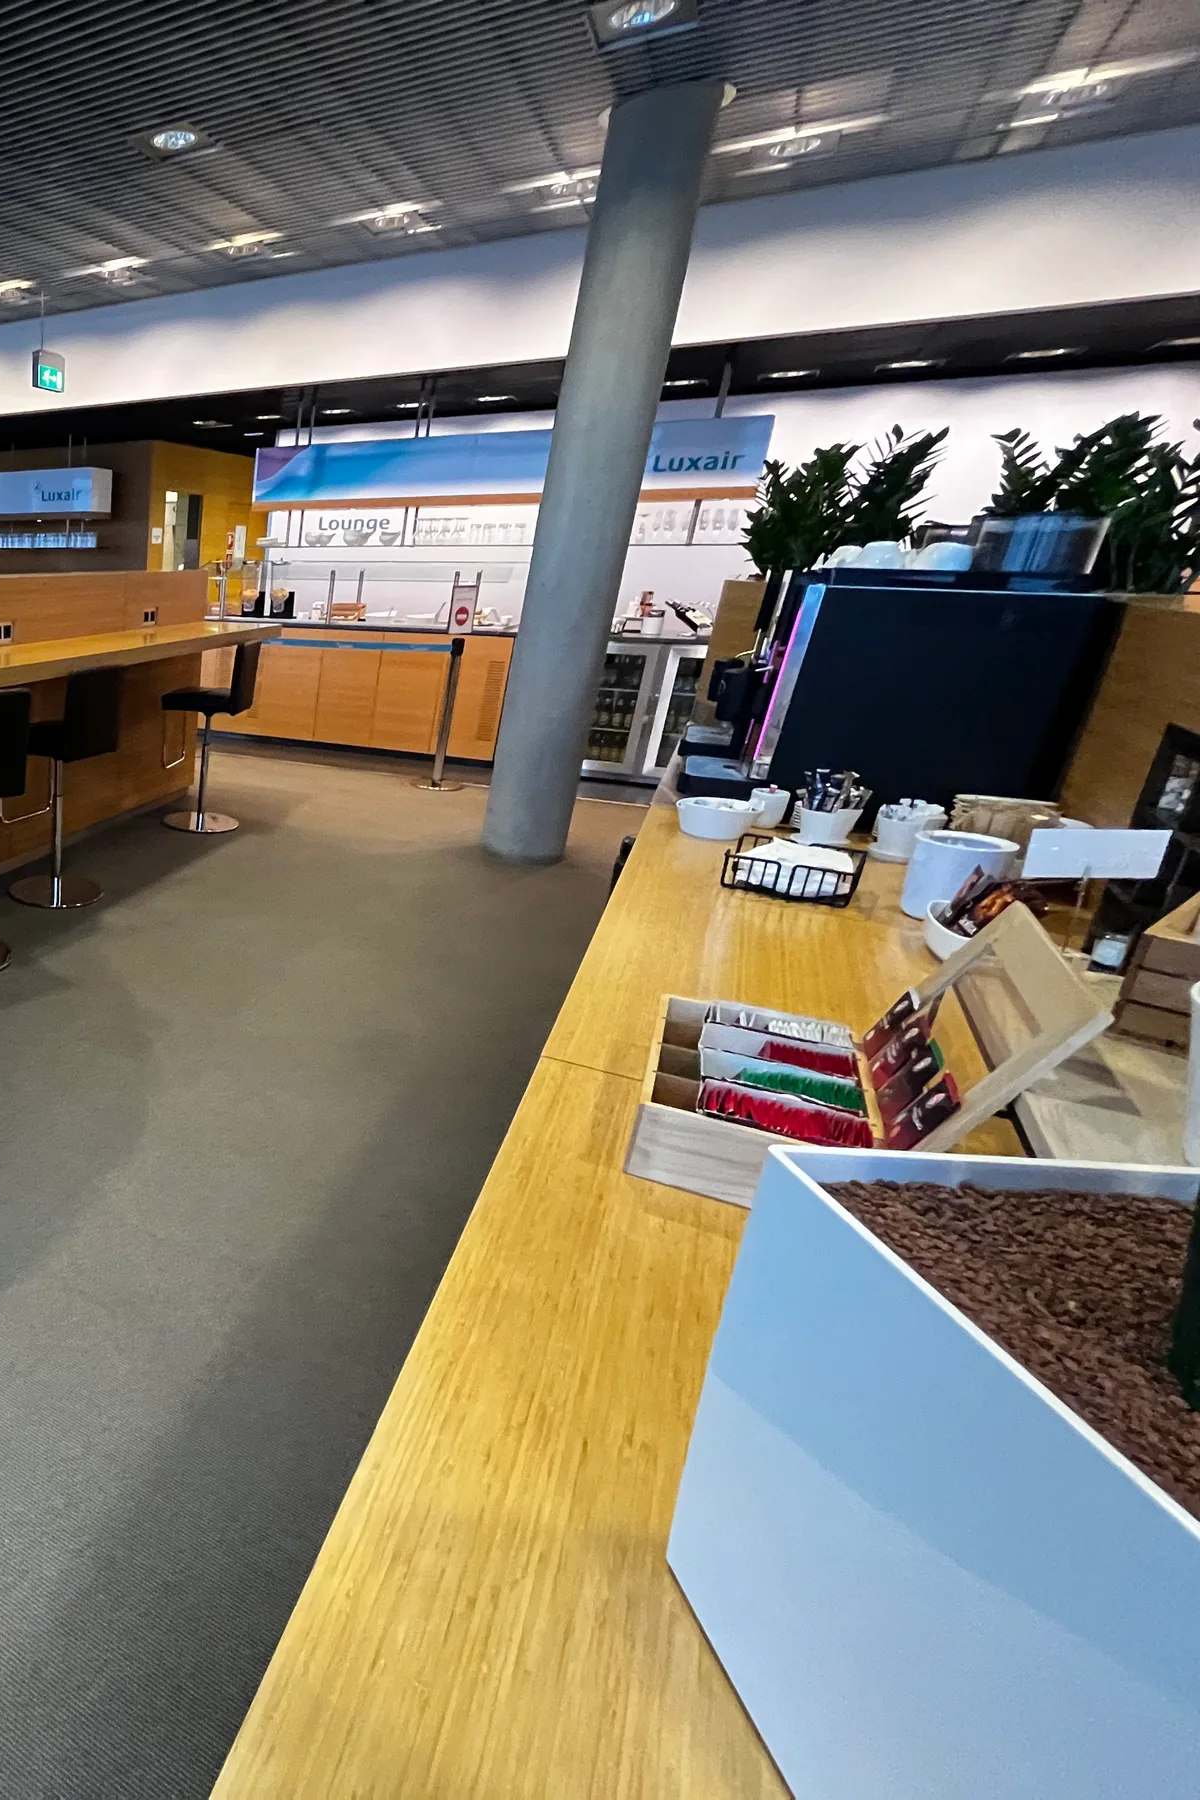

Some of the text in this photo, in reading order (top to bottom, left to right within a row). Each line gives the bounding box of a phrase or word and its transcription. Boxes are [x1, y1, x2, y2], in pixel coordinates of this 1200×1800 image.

[652, 451, 746, 472] Luxair
[41, 488, 82, 502] Luxair
[318, 516, 390, 534] Lounge
